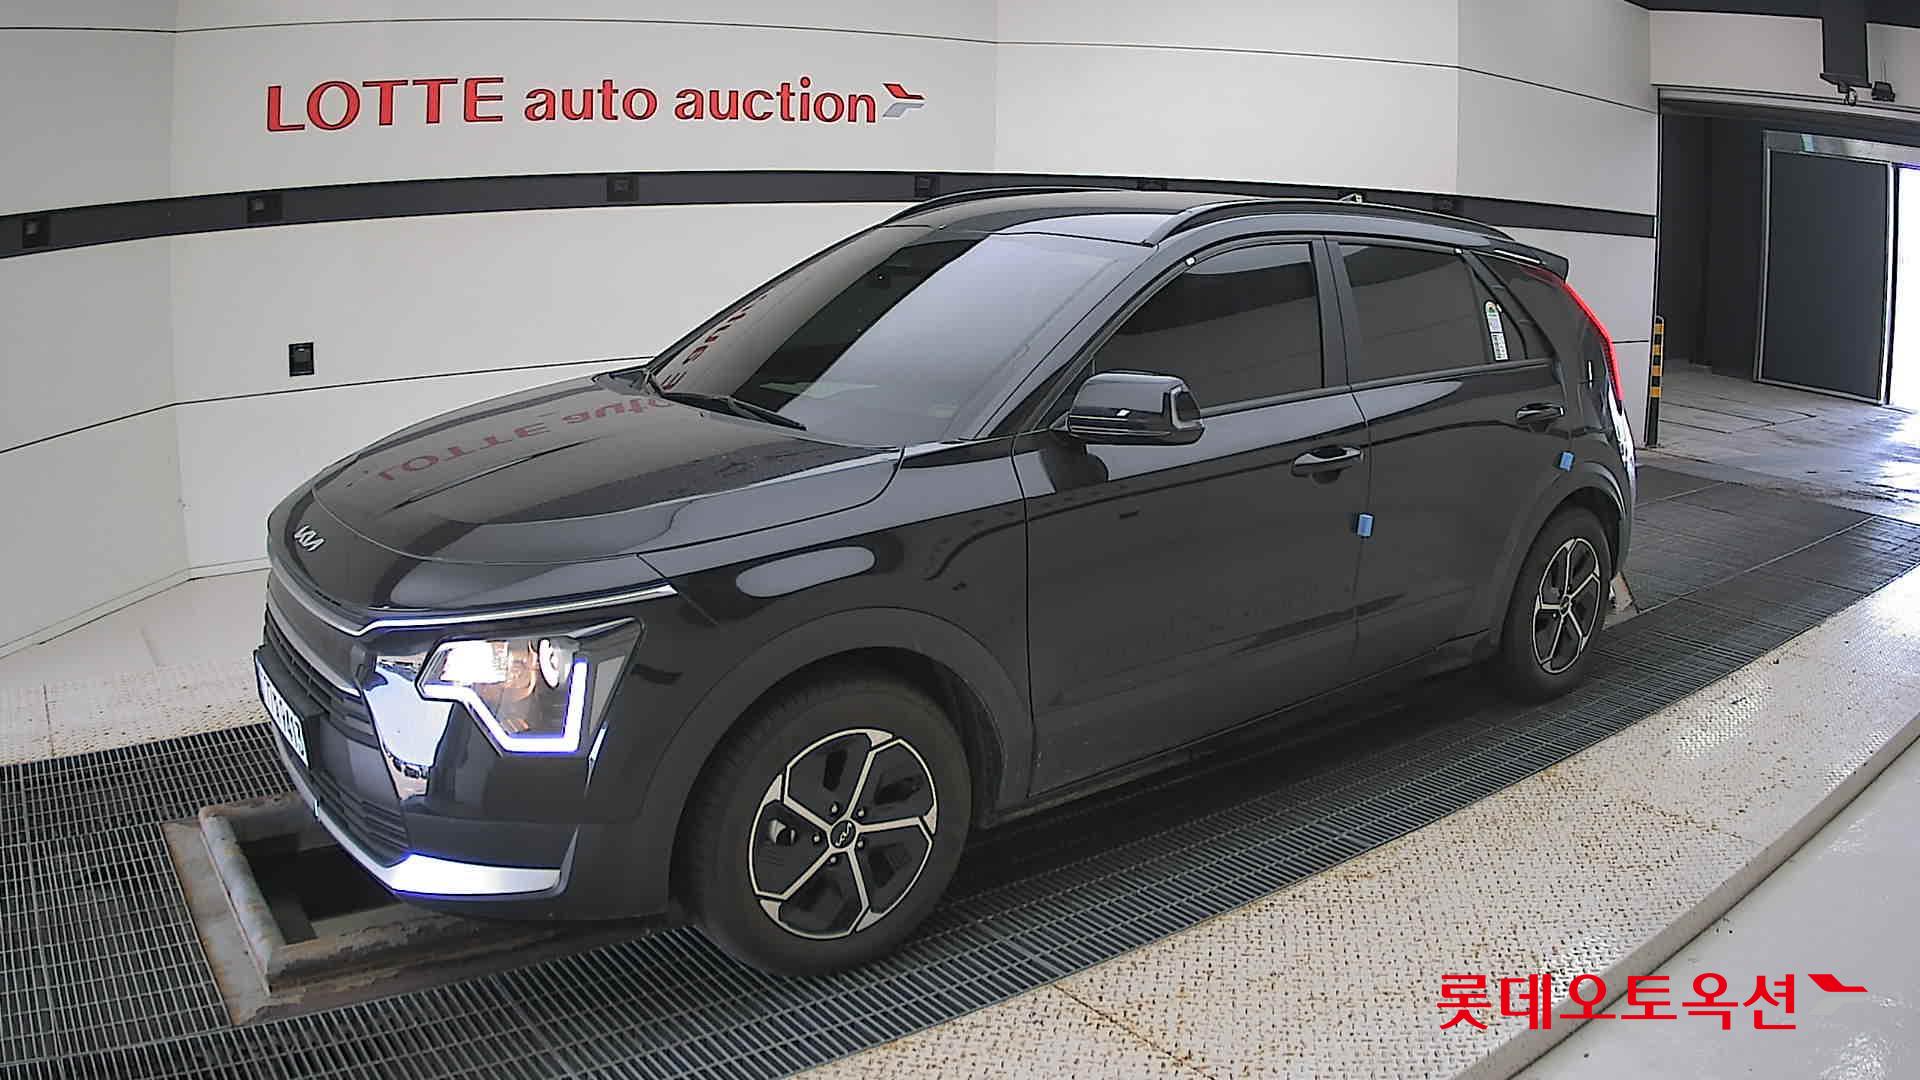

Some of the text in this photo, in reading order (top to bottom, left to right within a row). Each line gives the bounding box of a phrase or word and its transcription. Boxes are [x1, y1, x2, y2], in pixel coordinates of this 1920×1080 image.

[266, 76, 877, 132] LOTTE auto auction
